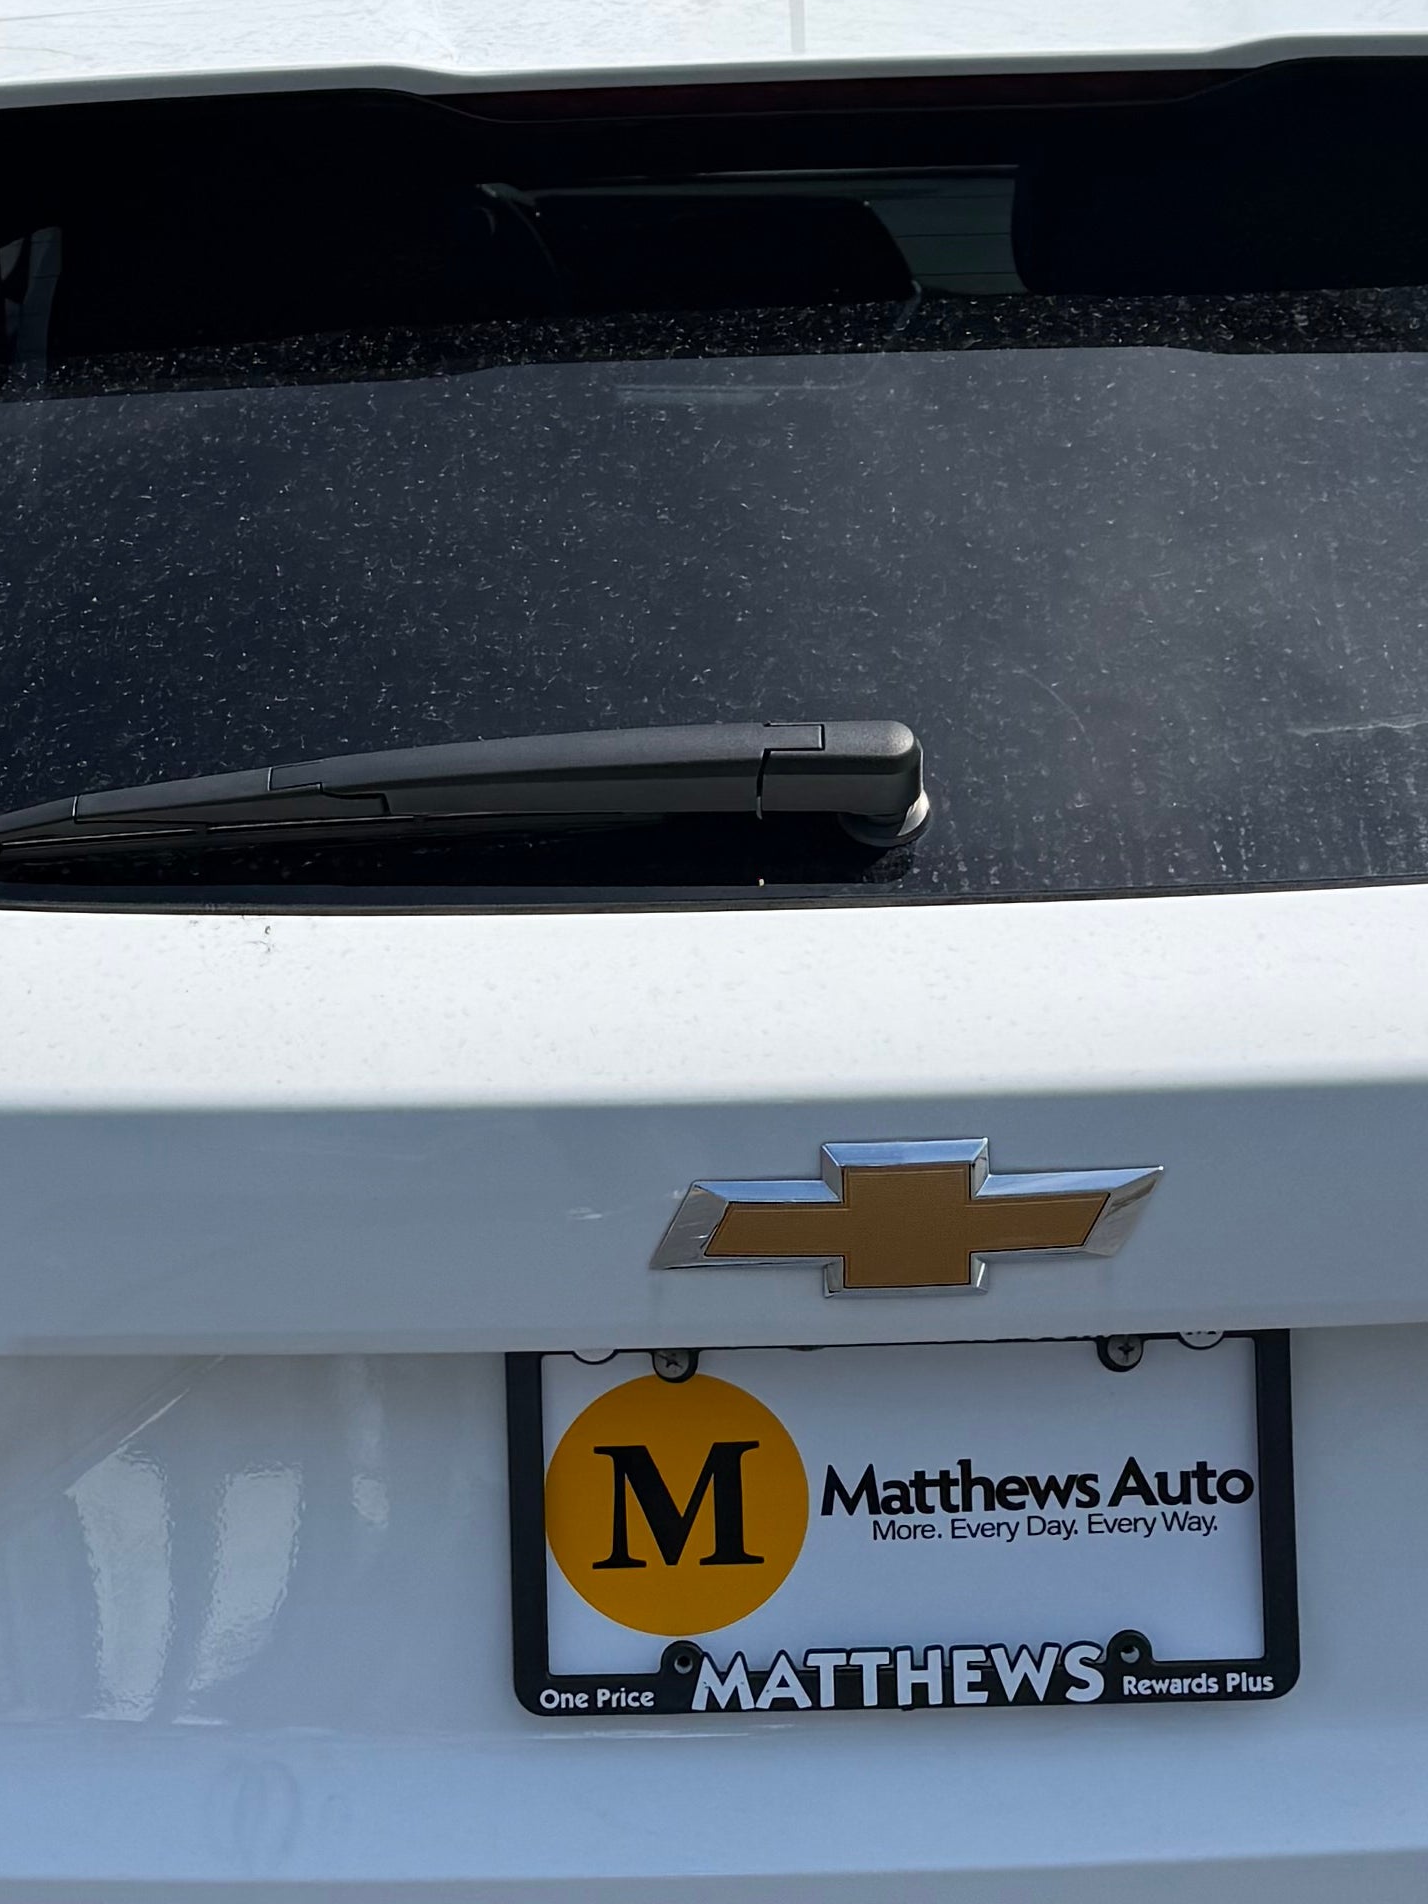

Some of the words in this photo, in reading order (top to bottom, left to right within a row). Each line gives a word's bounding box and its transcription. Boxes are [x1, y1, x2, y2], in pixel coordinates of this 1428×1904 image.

[592, 1440, 765, 1570] M
[821, 1458, 1101, 1517] Matthews
[1107, 1455, 1255, 1508] Auto
[872, 1519, 943, 1541] More.
[950, 1518, 1020, 1543] Every
[1026, 1515, 1079, 1541] Day.
[1087, 1512, 1157, 1539] Every
[1160, 1510, 1218, 1537] Way.
[539, 1689, 589, 1709] One
[597, 1687, 654, 1709] Price
[691, 1643, 1105, 1712] MATTHEWS
[1123, 1672, 1219, 1695] Rewards
[1226, 1671, 1274, 1693] Plus
